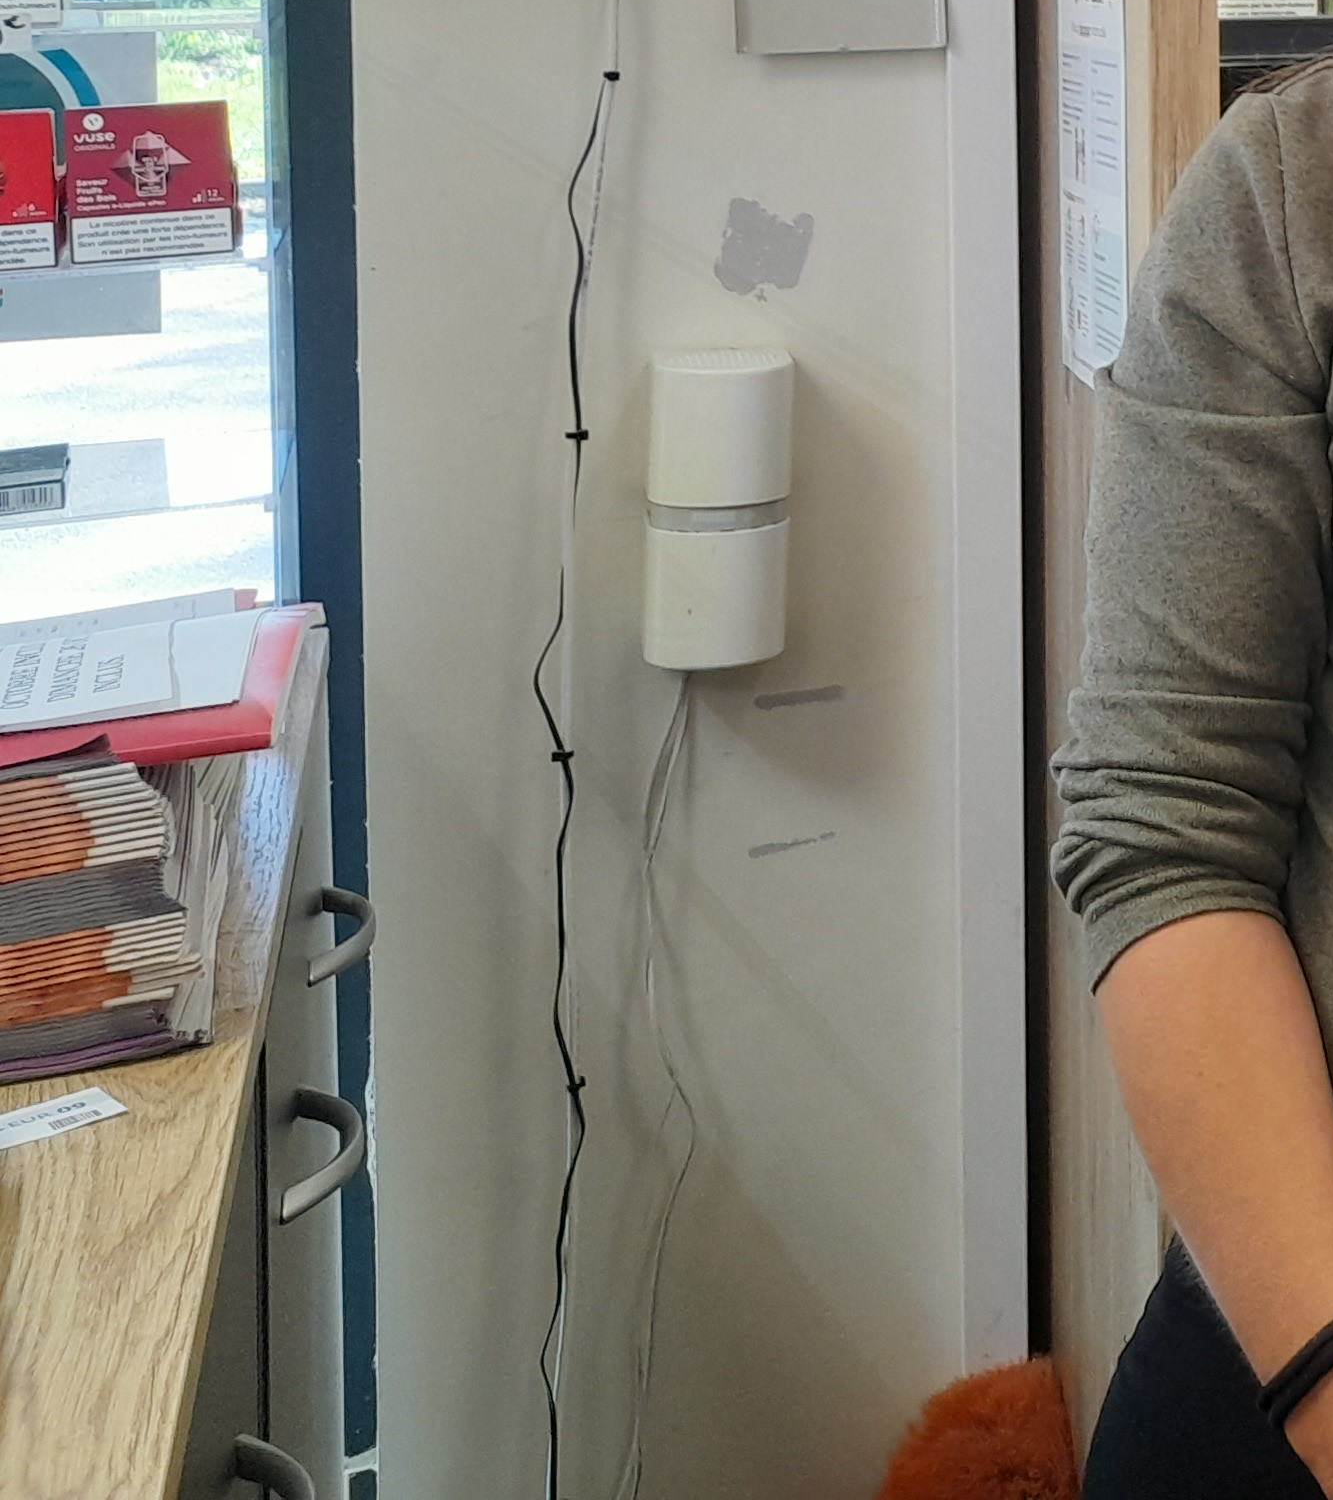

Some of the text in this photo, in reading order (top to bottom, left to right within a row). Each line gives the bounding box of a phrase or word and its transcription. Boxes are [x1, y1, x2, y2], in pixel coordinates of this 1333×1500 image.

[73, 143, 116, 152] ORIGINALS
[75, 178, 109, 188] Saveur
[75, 186, 103, 195] Fruits
[76, 194, 117, 204] des Bois
[89, 213, 216, 229] La nicotine contenue dans ce
[77, 230, 110, 241] produit
[111, 227, 131, 237] crée
[132, 227, 150, 236] une
[150, 224, 172, 234] forte
[77, 240, 96, 249] Son
[97, 235, 141, 247] utilisation
[142, 235, 157, 245] par
[158, 233, 172, 242] les
[125, 246, 142, 256] pas
[46, 652, 84, 703] DIMANCHE
